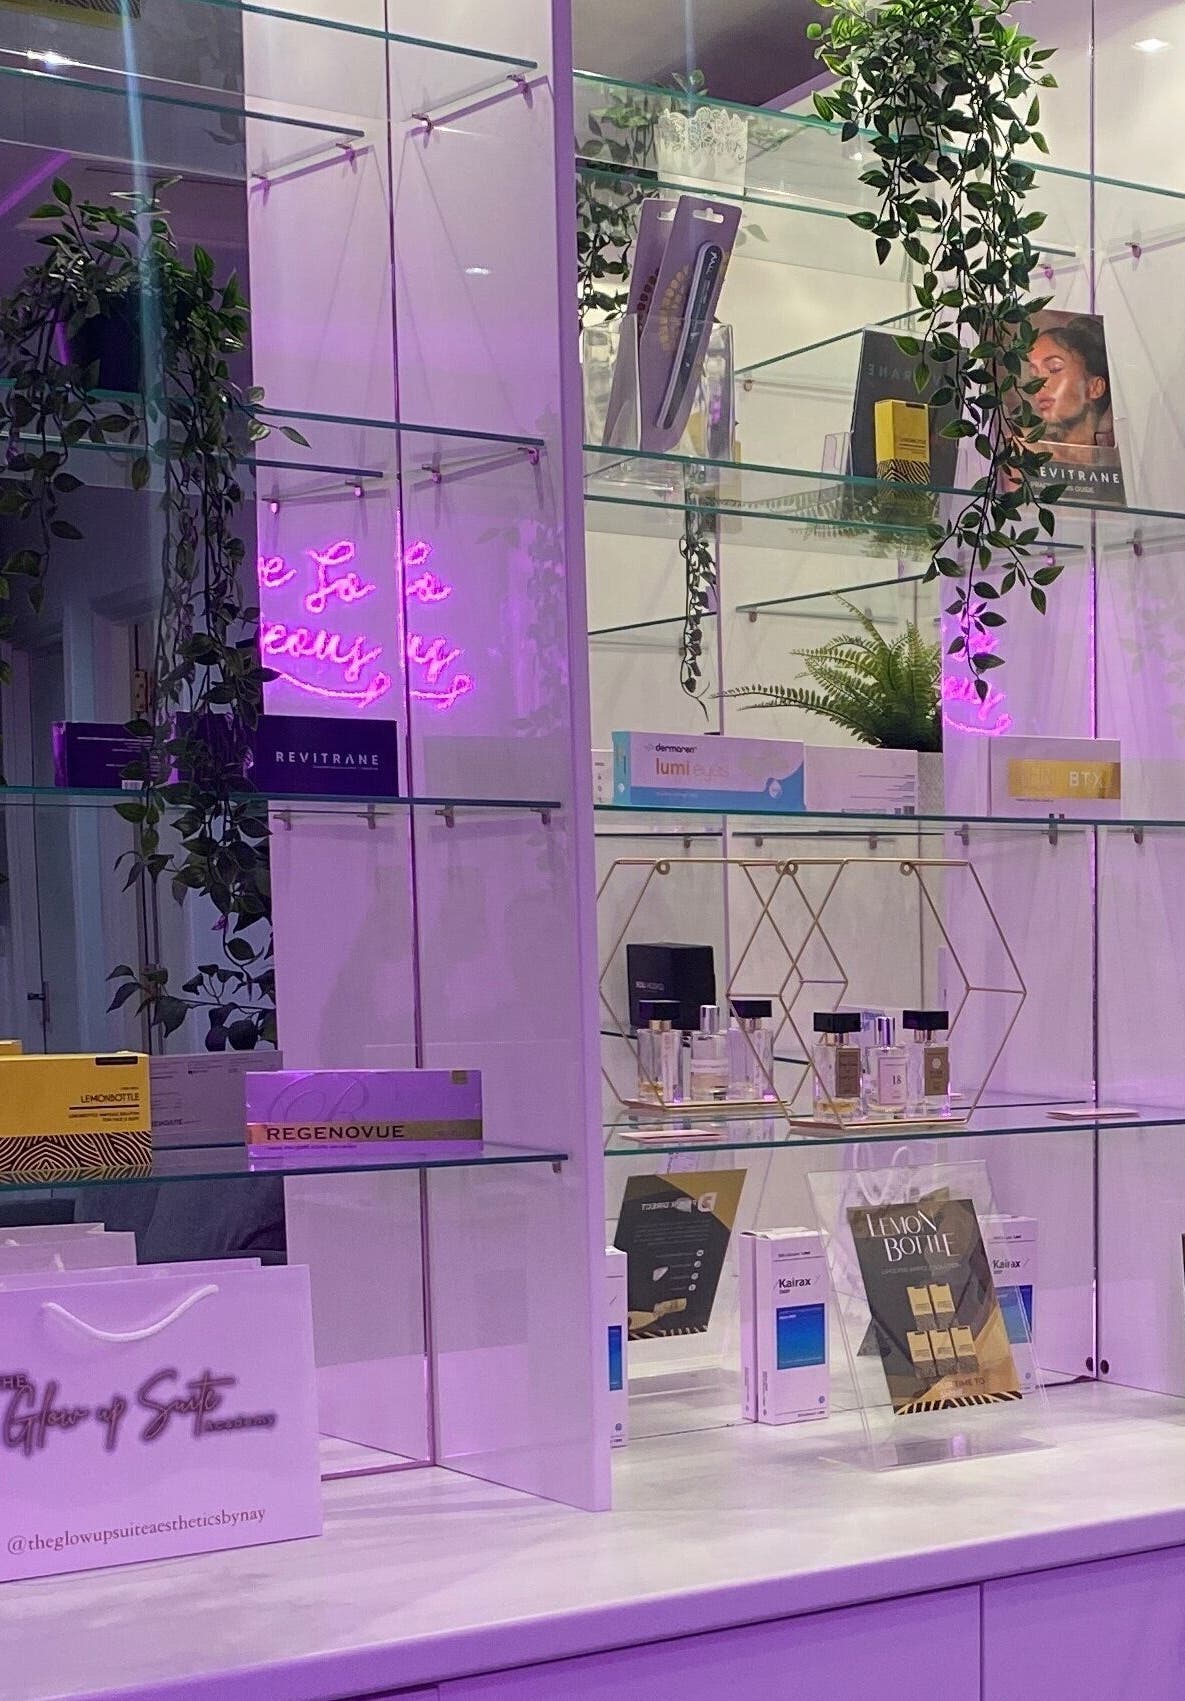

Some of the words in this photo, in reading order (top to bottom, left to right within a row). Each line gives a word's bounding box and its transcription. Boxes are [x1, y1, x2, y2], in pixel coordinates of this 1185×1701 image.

[1039, 466, 1120, 484] EVITRANE
[275, 751, 379, 765] REVITRANE
[656, 757, 690, 775] lumi
[892, 1074, 902, 1085] 18
[80, 1092, 140, 1103] LEMONBOTTLE
[266, 1125, 405, 1141] REGENOVUE
[866, 1210, 939, 1237] LEMON
[884, 1233, 961, 1262] BOTTLE
[994, 1259, 1021, 1269] Kairax
[778, 1278, 811, 1289] Kairax
[0, 1374, 28, 1389] HE
[3, 1379, 89, 1456] Glow
[96, 1394, 127, 1451] up
[137, 1368, 237, 1441] Suite
[7, 1508, 267, 1556] @theglowupsuiteaestheticsbynay
